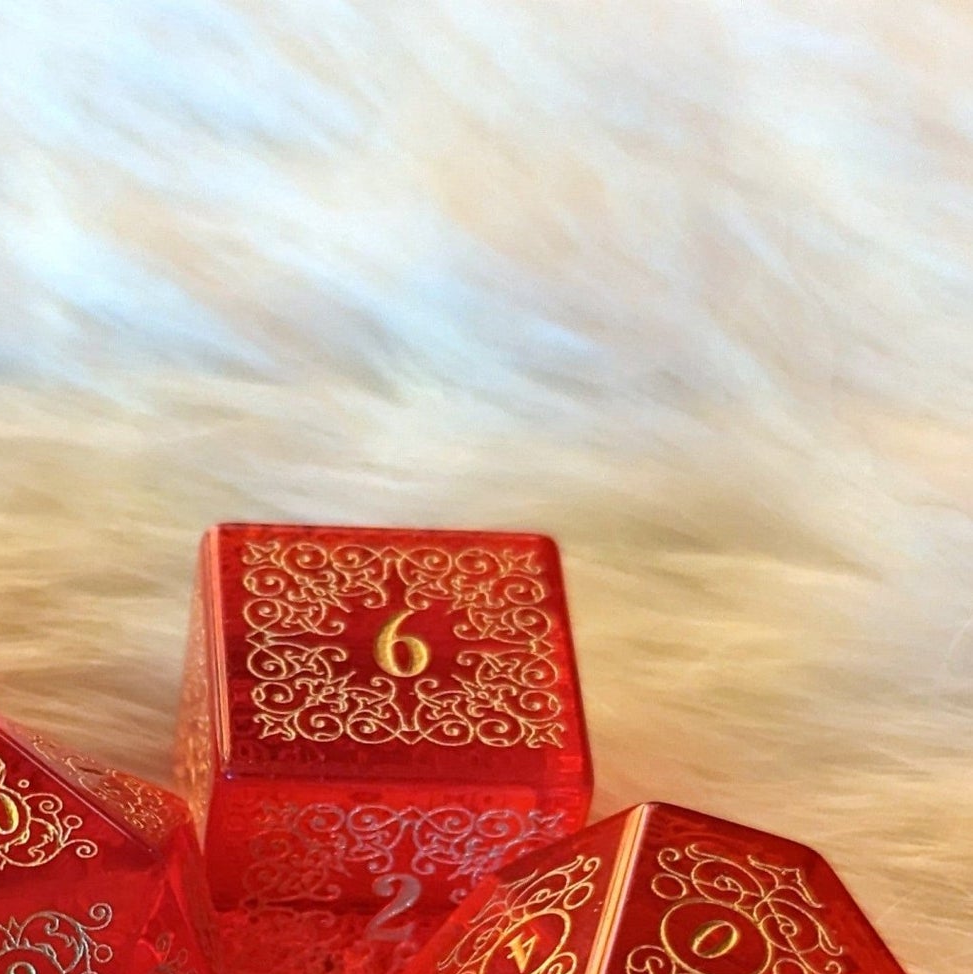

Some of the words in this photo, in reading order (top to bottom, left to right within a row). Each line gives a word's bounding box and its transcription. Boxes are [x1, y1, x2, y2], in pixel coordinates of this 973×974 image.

[373, 609, 428, 678] 6
[366, 873, 423, 942] 2
[507, 934, 537, 974] 4
[690, 919, 740, 960] 0
